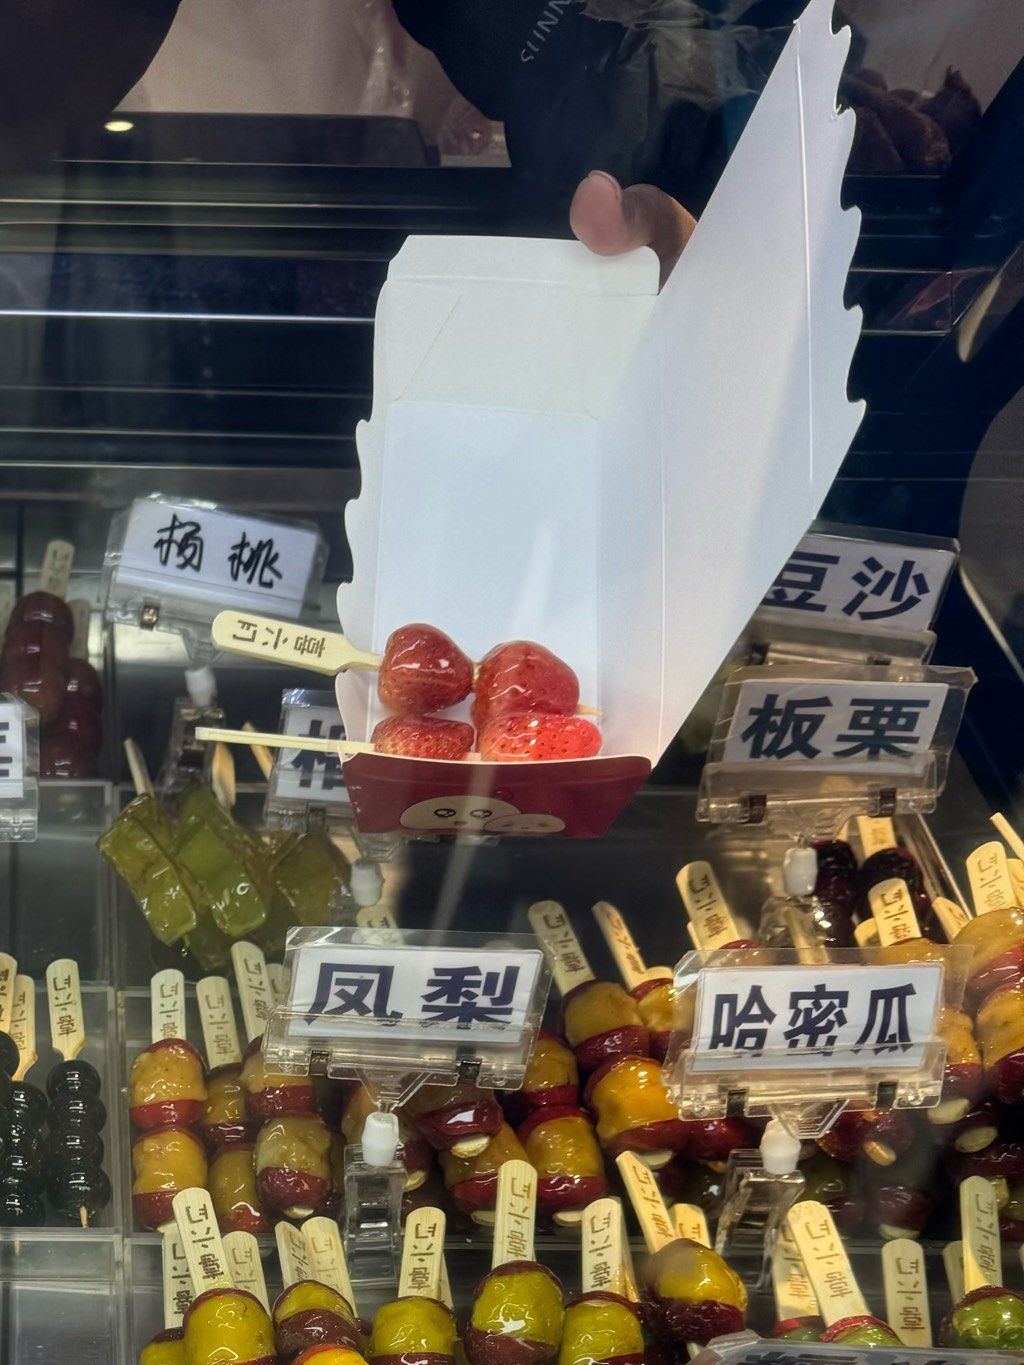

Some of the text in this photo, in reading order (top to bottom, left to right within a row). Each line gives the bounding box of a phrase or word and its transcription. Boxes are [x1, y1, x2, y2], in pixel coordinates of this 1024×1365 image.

[153, 513, 283, 589] 杨桃
[760, 550, 930, 621] 豆沙
[740, 694, 931, 760] 板栗
[304, 961, 522, 1030] 凤梨
[708, 982, 917, 1058] 哈密瓜
